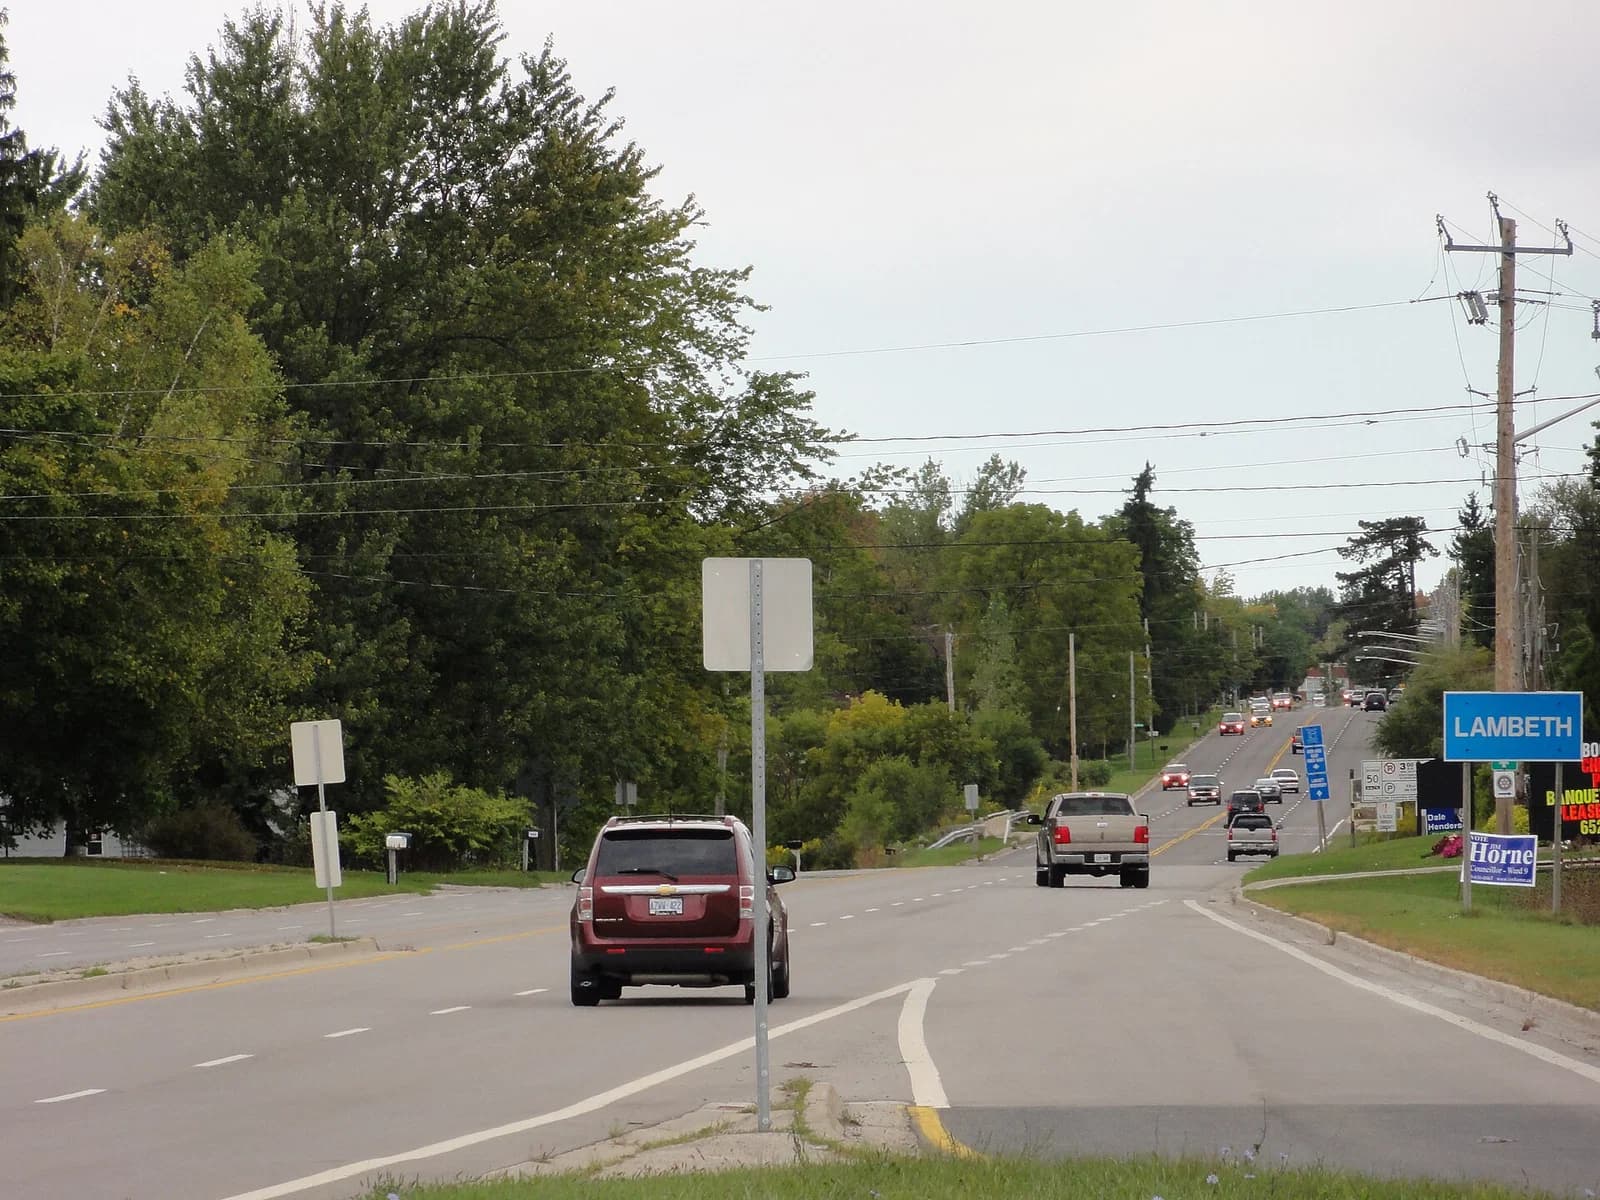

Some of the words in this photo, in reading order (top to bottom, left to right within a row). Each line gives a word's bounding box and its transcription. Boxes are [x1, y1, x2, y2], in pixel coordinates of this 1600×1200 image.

[1454, 716, 1572, 737] LAMBETH
[1367, 775, 1379, 783] 50
[1471, 842, 1534, 865] Horne
